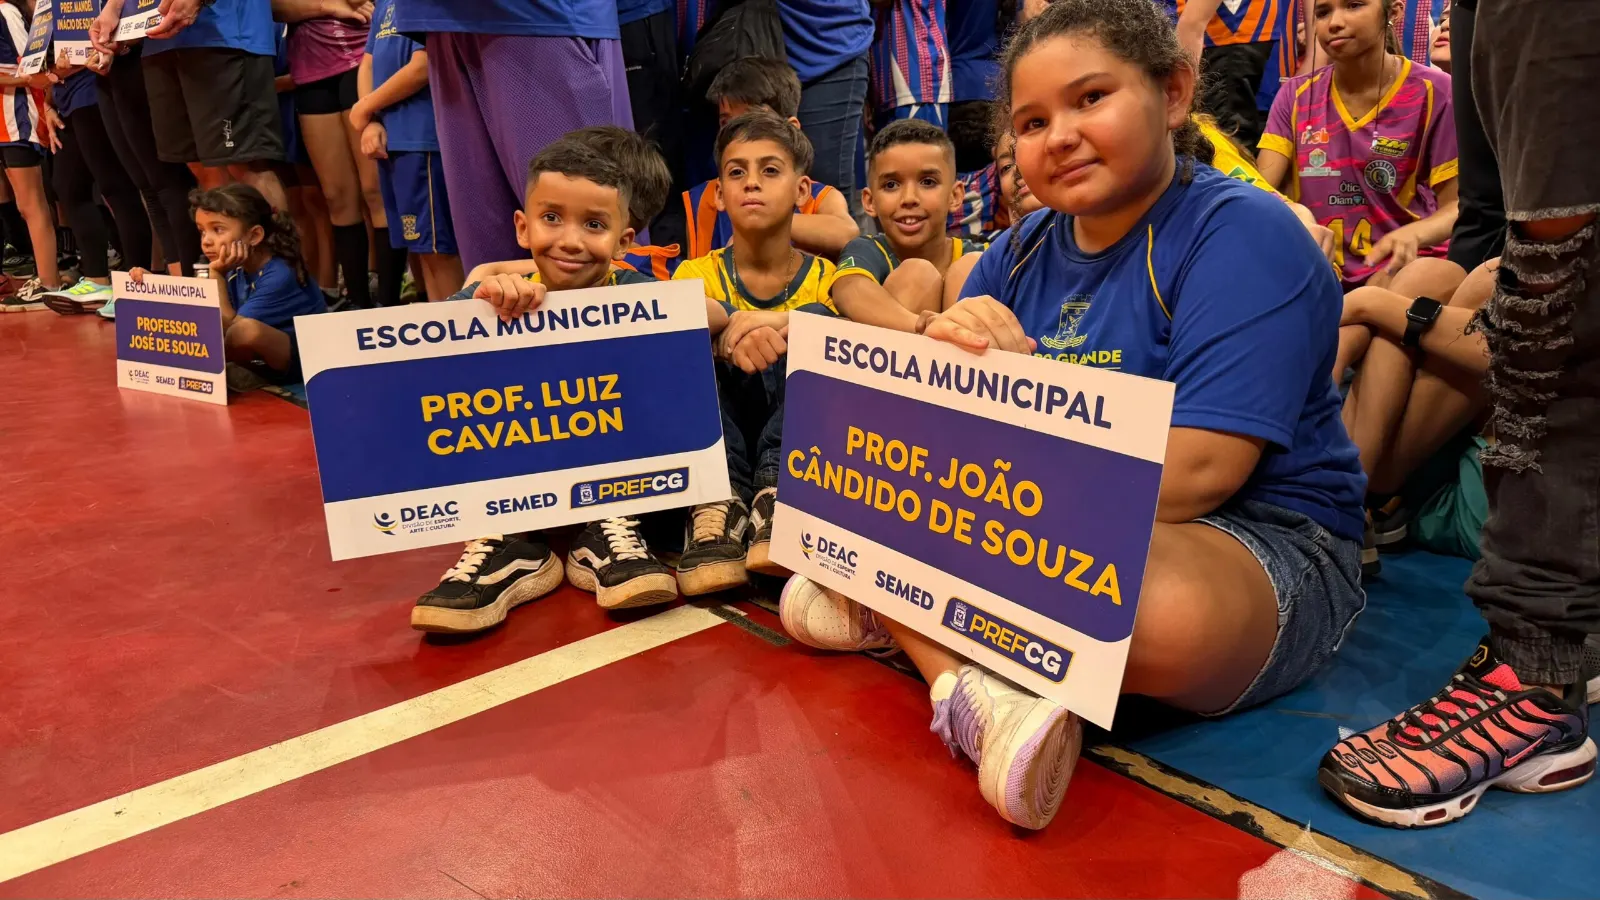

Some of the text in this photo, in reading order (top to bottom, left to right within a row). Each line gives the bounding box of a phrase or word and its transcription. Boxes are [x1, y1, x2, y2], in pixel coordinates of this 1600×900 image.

[125, 281, 206, 298] ESCOLA MUNICIPAL
[137, 317, 197, 336] PROFESSOR
[356, 298, 668, 351] ESCOLA MUNICIPAL
[129, 332, 209, 358] JOSÉ DE SOUZA
[156, 376, 175, 385] SEMED
[823, 335, 1113, 430] ESCOLA MUNICIPAL
[421, 373, 622, 422] PROF. LUIZ
[427, 407, 624, 456] CAVALLON
[598, 472, 684, 499] PREFCG
[846, 425, 1044, 517] PROF. JOÃO
[400, 500, 459, 522] DEAC
[485, 492, 558, 517] SEMED
[402, 520, 425, 530] DIVISÃO
[430, 523, 455, 531] CULTURA
[787, 446, 1123, 606] CÂNDIDO DE SOUZA
[817, 536, 858, 568] DEAC
[874, 569, 935, 612] SEMED
[968, 614, 1064, 676] PREFCG
